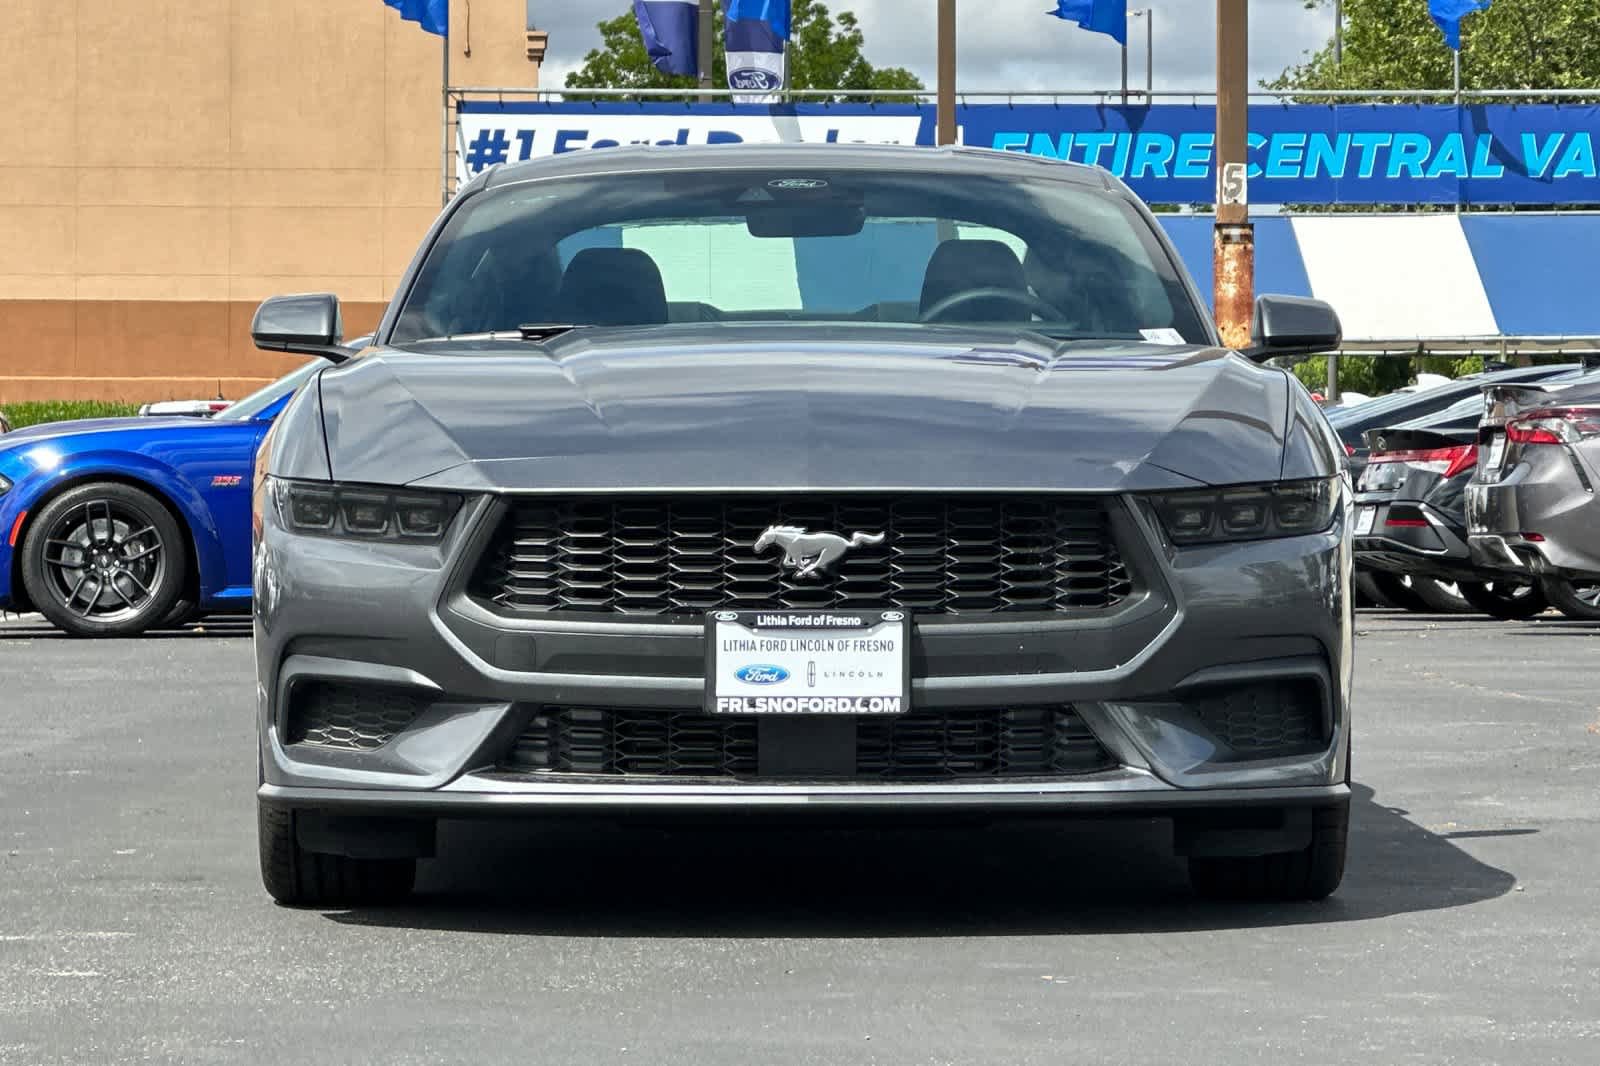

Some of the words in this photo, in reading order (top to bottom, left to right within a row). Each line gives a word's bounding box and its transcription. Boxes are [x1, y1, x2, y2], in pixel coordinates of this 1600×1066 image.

[757, 615, 787, 626] Lithia
[789, 615, 811, 626] Ford
[813, 615, 825, 626] of
[827, 615, 861, 626] Fresno
[723, 640, 757, 652] LITHIA
[760, 640, 787, 652] FORD
[790, 640, 834, 652] LINCOLN
[837, 640, 850, 652] OF
[853, 640, 894, 652] FRESNO
[744, 669, 778, 682] Ford
